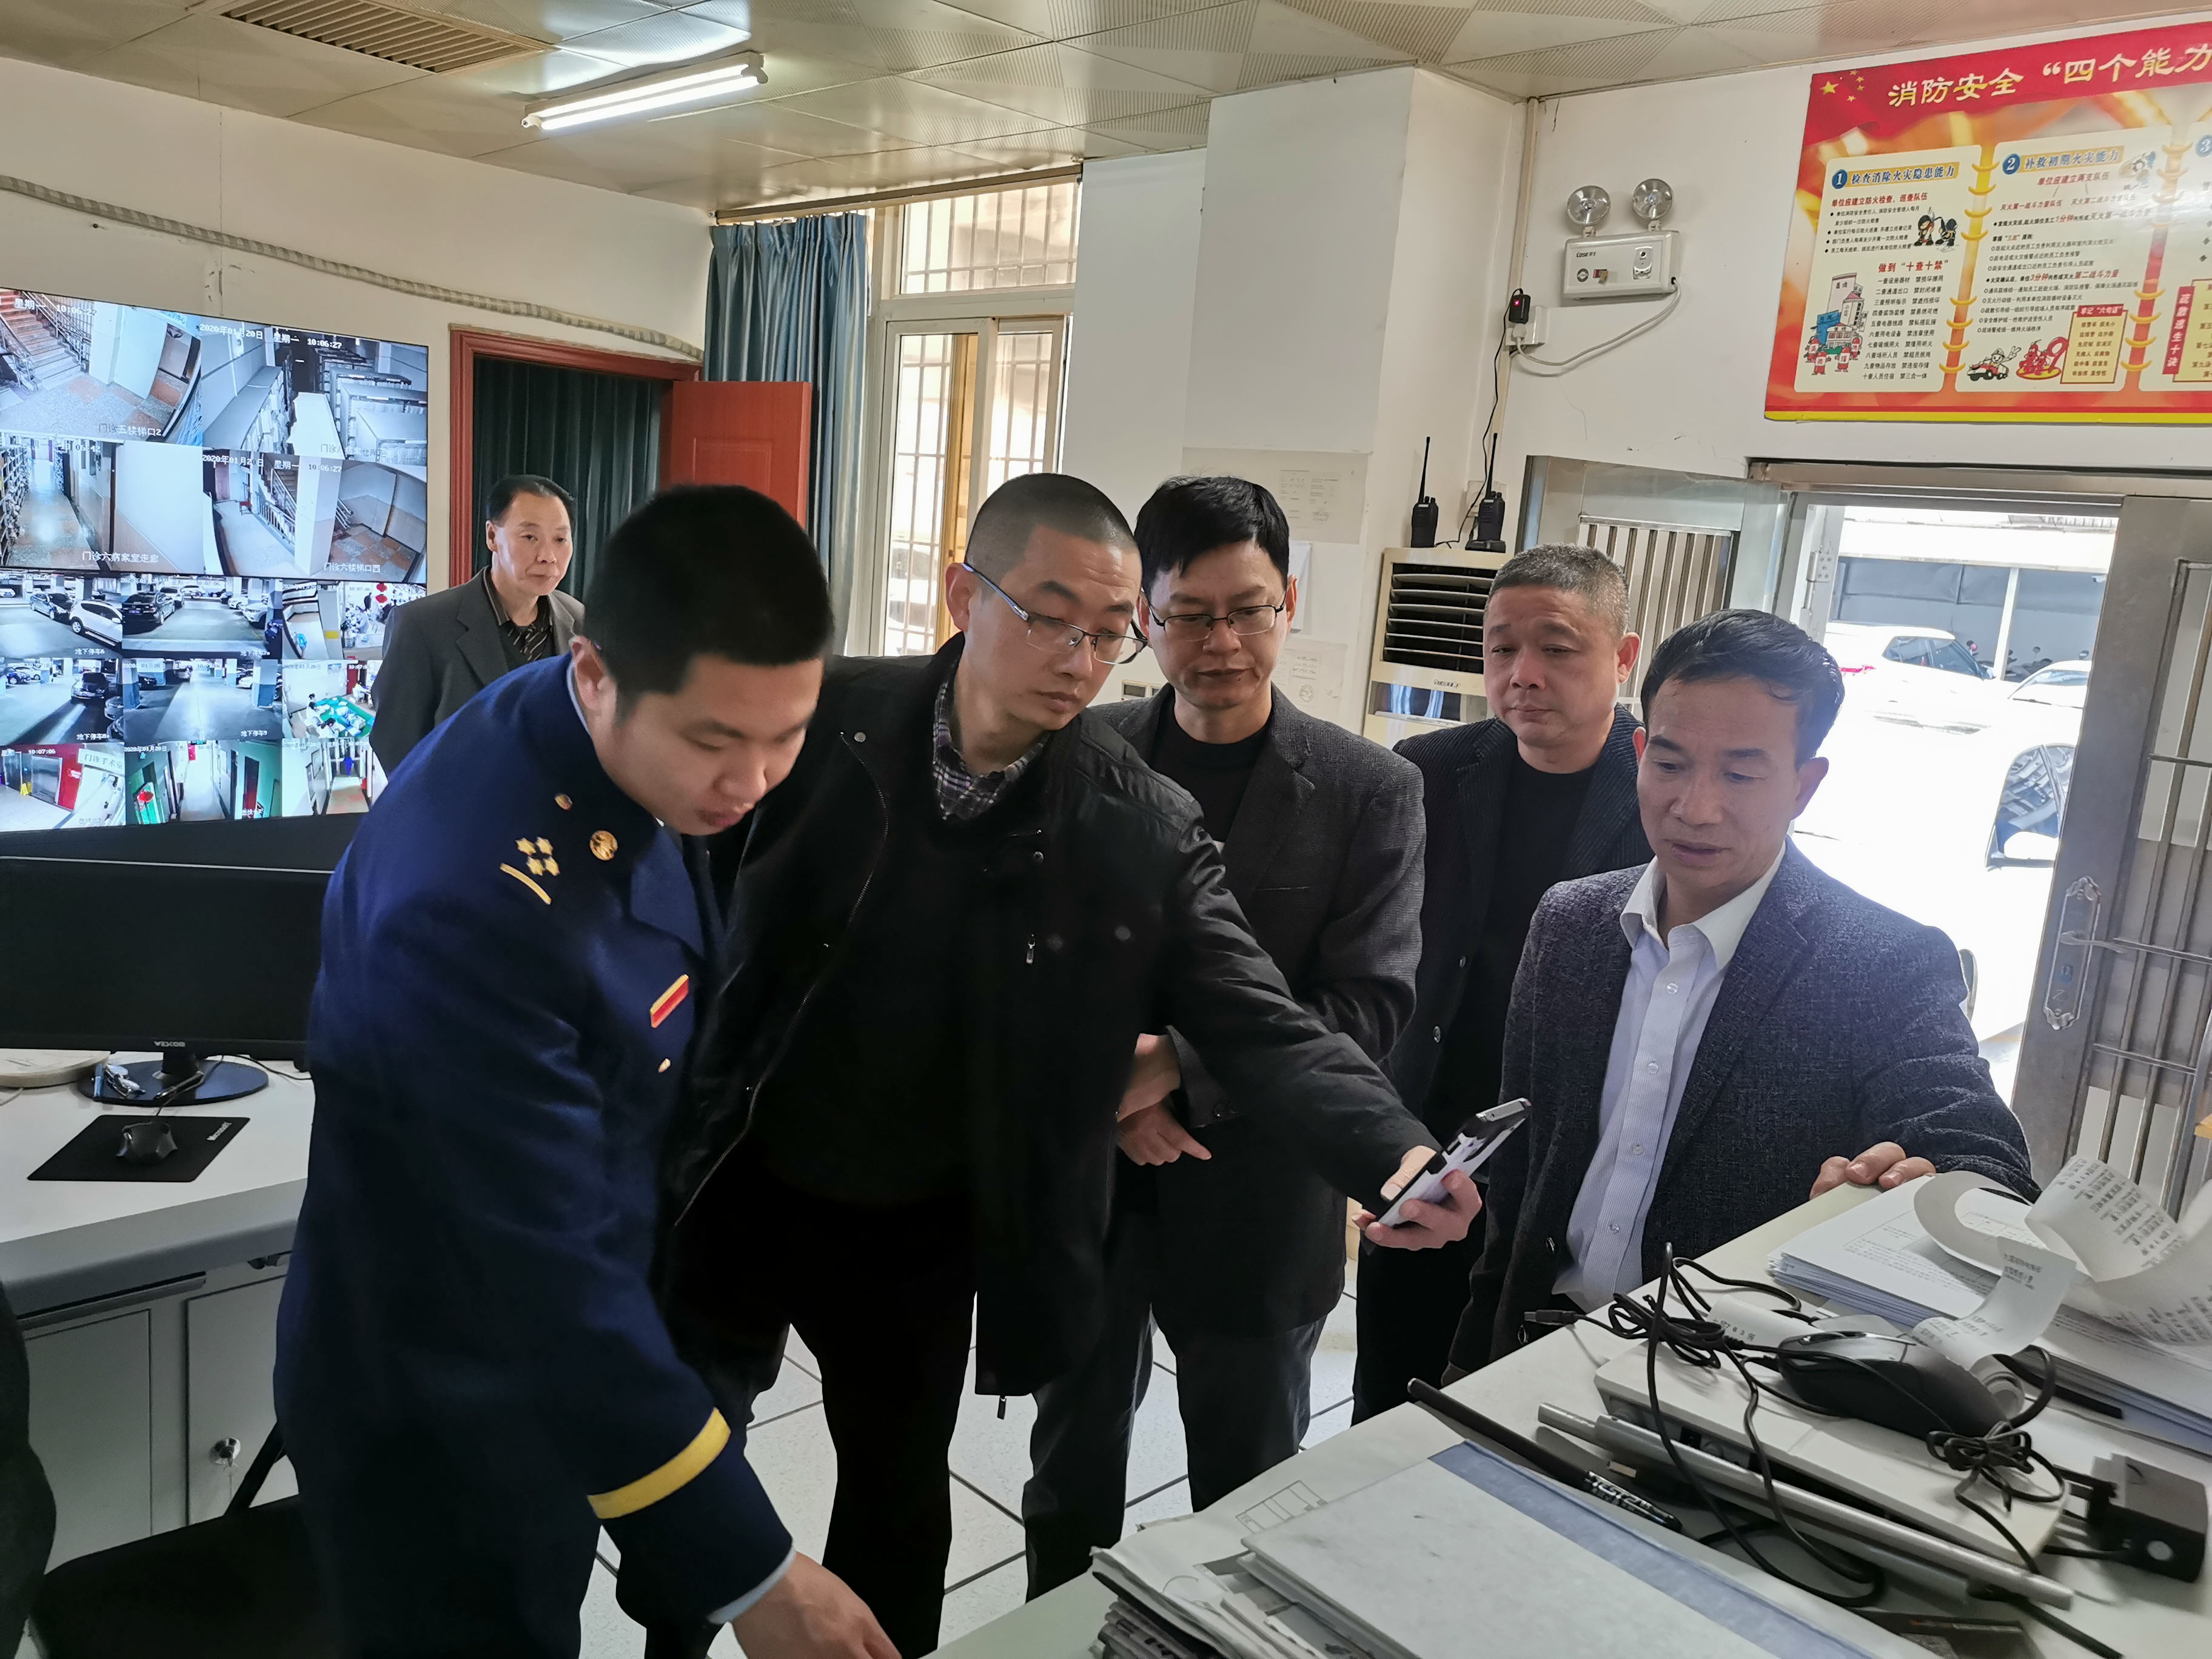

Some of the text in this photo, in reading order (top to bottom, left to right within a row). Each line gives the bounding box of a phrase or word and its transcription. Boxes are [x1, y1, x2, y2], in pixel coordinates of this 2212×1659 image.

[2006, 158, 2016, 172] 2
[1836, 166, 1954, 185] 1 检查消除火灾隐患能力
[307, 338, 342, 349] 10:06:27
[98, 423, 162, 436] 门诊五楼梯口2
[203, 455, 264, 467] 2020年01月20日
[309, 464, 341, 472] 10:06:27
[82, 551, 158, 563] 门诊六病案室走廊
